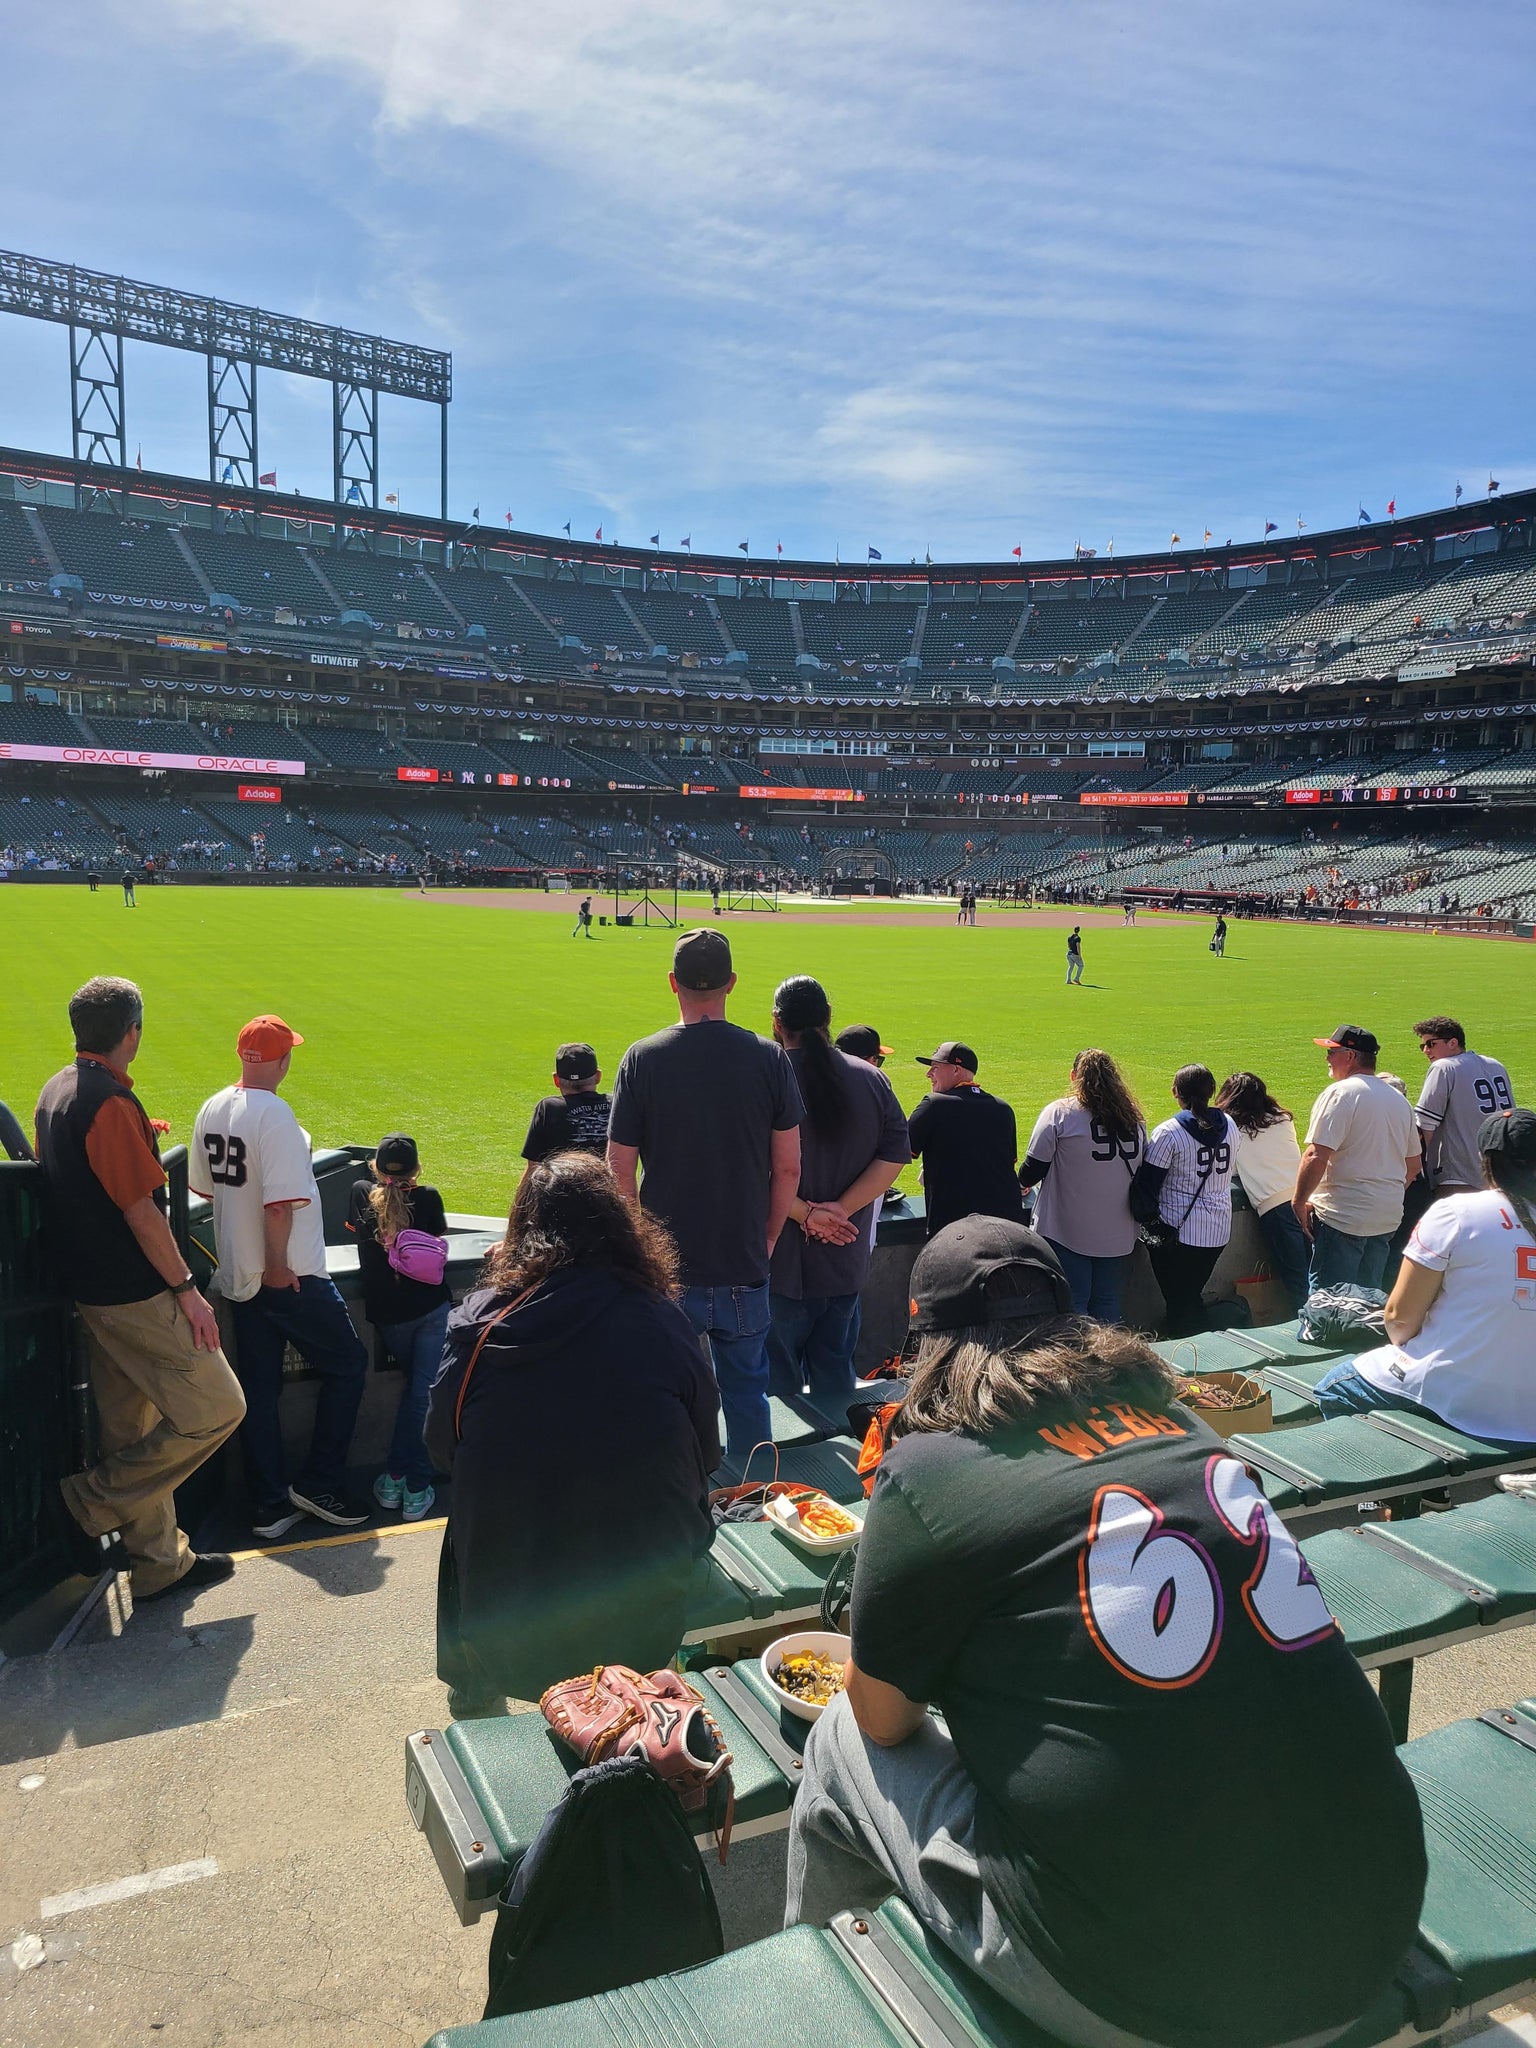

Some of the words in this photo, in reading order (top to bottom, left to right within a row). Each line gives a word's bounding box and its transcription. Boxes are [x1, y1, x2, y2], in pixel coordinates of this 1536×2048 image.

[24, 626, 52, 634] TOYOTA
[310, 653, 360, 669] CUTWATER
[62, 749, 153, 766] ORACLE
[197, 757, 279, 773] ORACLE
[406, 769, 431, 778] Adobe
[484, 773, 492, 784] 0
[524, 776, 532, 786] 0
[541, 777, 549, 787] 0
[553, 778, 560, 788] 0
[564, 778, 571, 788] 0
[245, 789, 276, 799] Adobe
[748, 787, 768, 797] 53.3
[992, 794, 998, 803] 0
[1004, 794, 1010, 803] 0
[1016, 794, 1022, 803] 0
[1292, 791, 1314, 799] Adobe
[1363, 789, 1370, 800] 0
[1404, 788, 1411, 799] 0
[1423, 788, 1430, 799] 0
[1436, 787, 1444, 799] 0
[1449, 787, 1457, 799] 0
[1472, 1075, 1512, 1114] 99
[203, 1132, 247, 1188] 28
[1196, 1142, 1231, 1178] 99
[1037, 1402, 1188, 1462] WEBB
[1078, 1454, 1337, 1691] 62
[412, 1784, 420, 1809] 3
